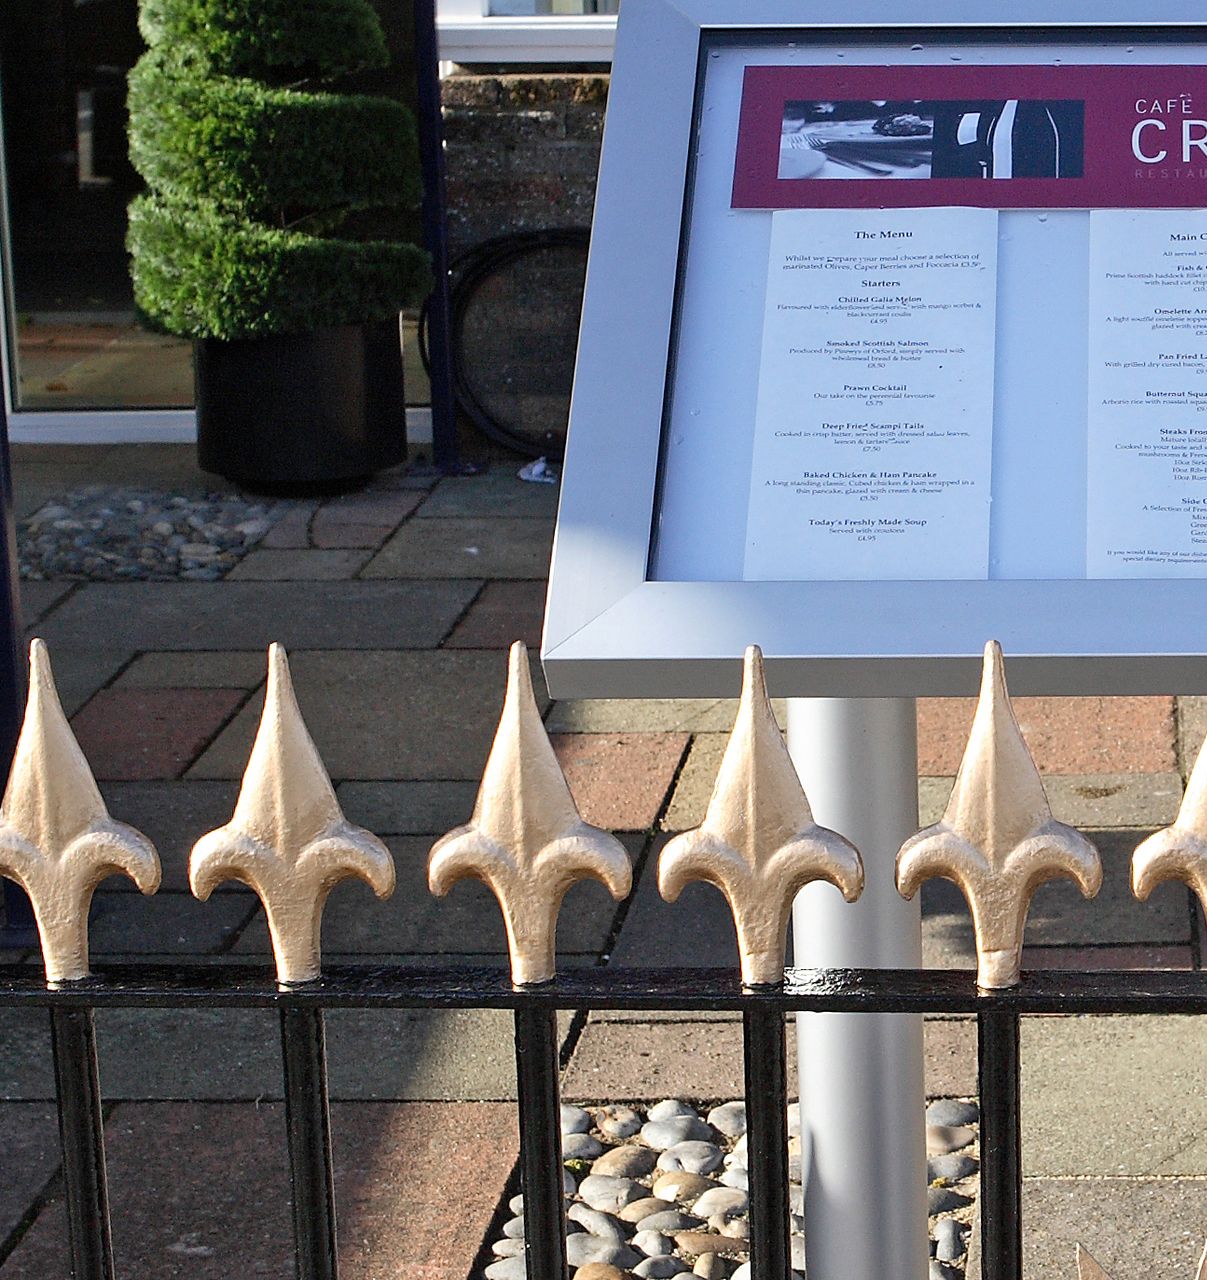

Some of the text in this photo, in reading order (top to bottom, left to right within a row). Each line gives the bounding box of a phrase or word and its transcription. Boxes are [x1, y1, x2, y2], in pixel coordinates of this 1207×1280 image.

[879, 230, 913, 238] Menu
[1170, 232, 1197, 241] Main
[1195, 263, 1203, 271] &
[1154, 307, 1192, 315] Omelette
[1158, 352, 1174, 360] Pan
[1146, 390, 1185, 398] Butternut
[822, 422, 844, 431] Deep
[869, 422, 901, 431] Scampi
[808, 518, 928, 528] Today's Freshly Made Soup
